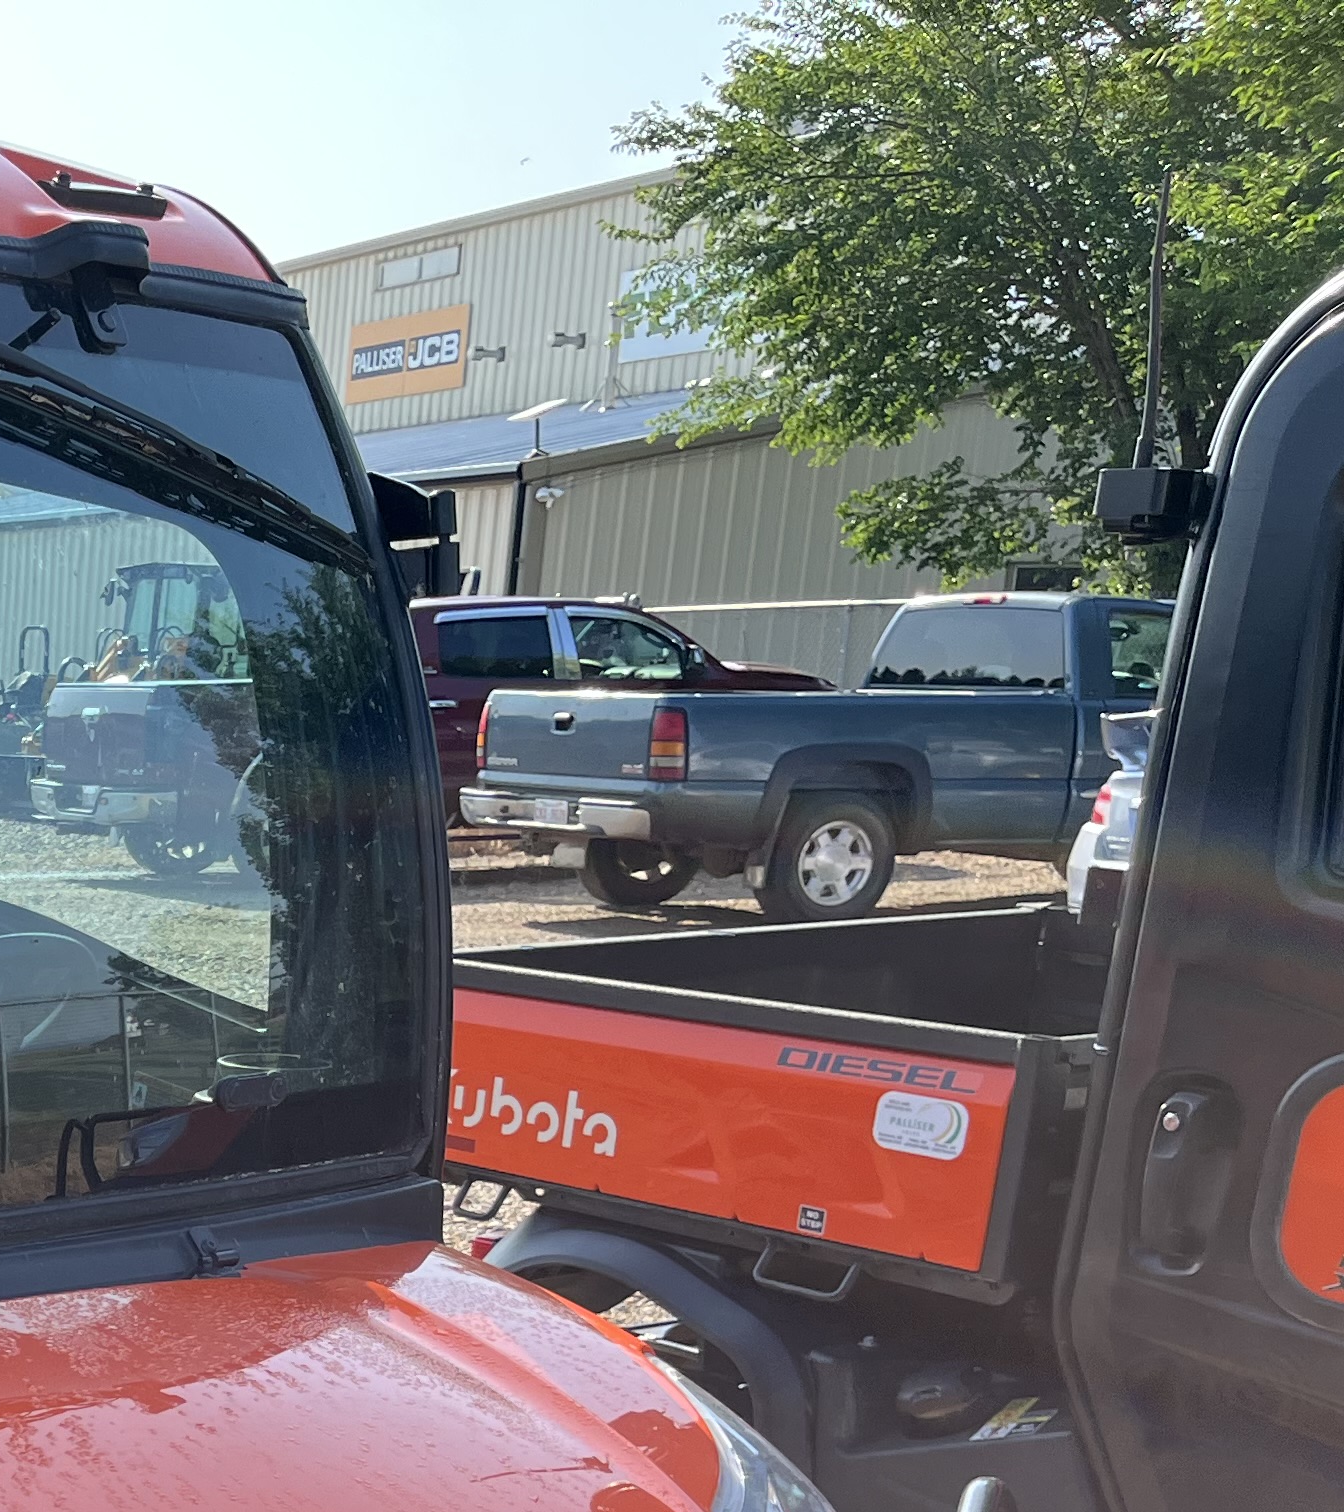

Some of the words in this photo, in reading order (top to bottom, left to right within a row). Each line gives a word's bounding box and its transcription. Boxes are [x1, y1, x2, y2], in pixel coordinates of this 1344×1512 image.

[352, 345, 404, 375] PALLISER
[408, 333, 459, 368] JCB
[777, 1046, 976, 1095] DIESEL
[448, 1069, 618, 1158] ubota
[806, 1210, 820, 1220] NO
